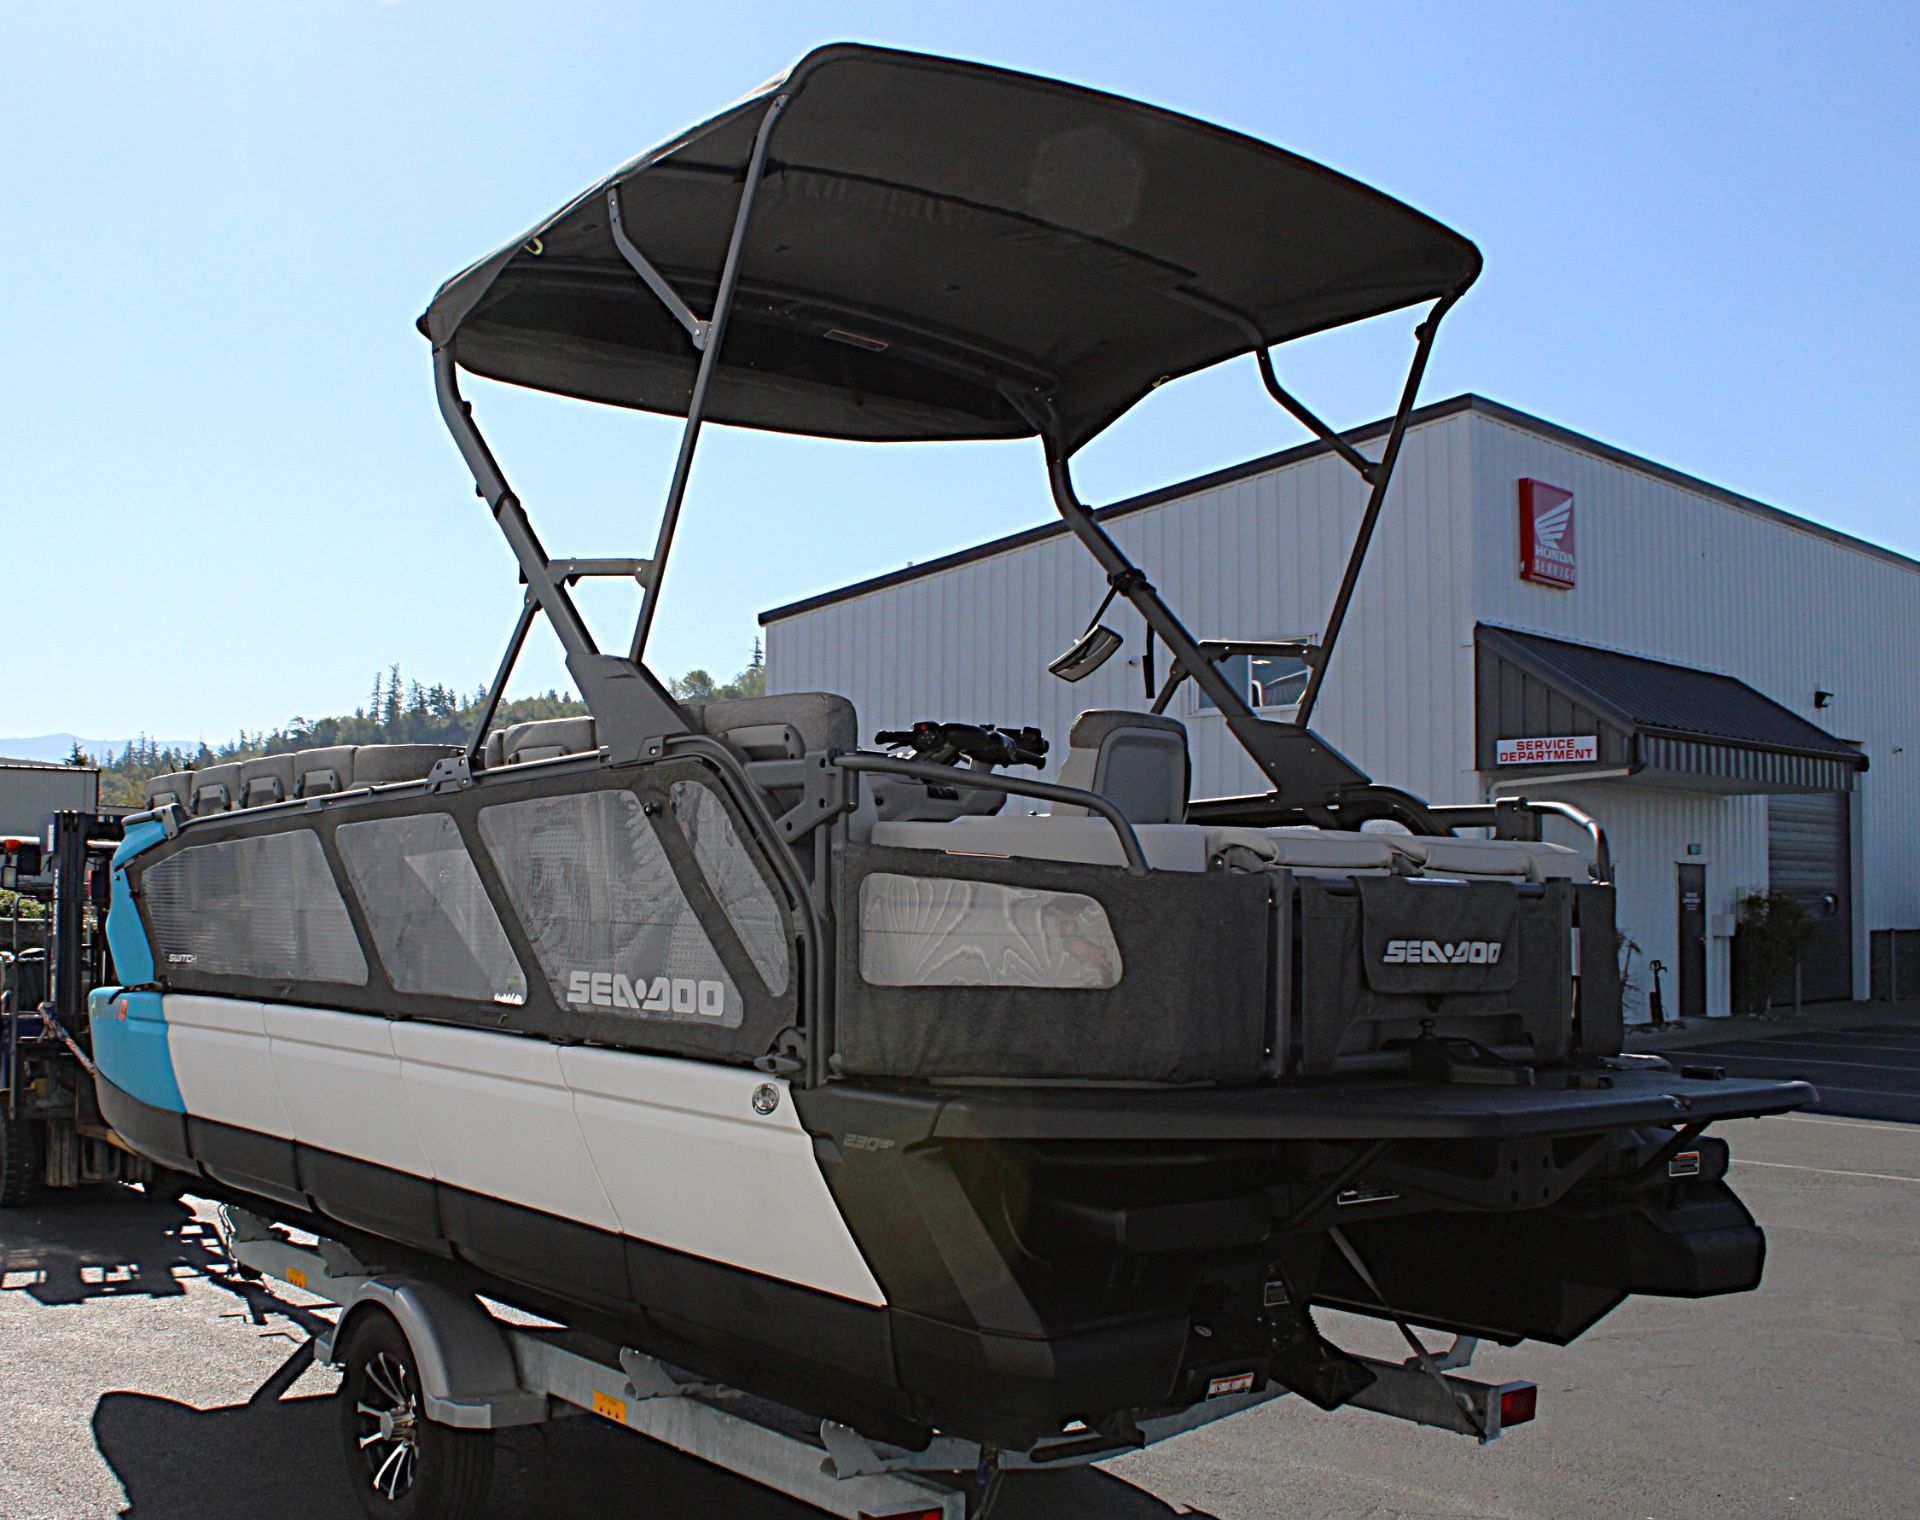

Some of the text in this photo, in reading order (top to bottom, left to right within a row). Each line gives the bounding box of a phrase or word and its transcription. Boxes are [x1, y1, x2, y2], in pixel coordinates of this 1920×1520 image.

[1534, 544, 1575, 566] HONDA
[1516, 739, 1575, 751] SERVICE
[1500, 748, 1594, 762] DEPARTMENT
